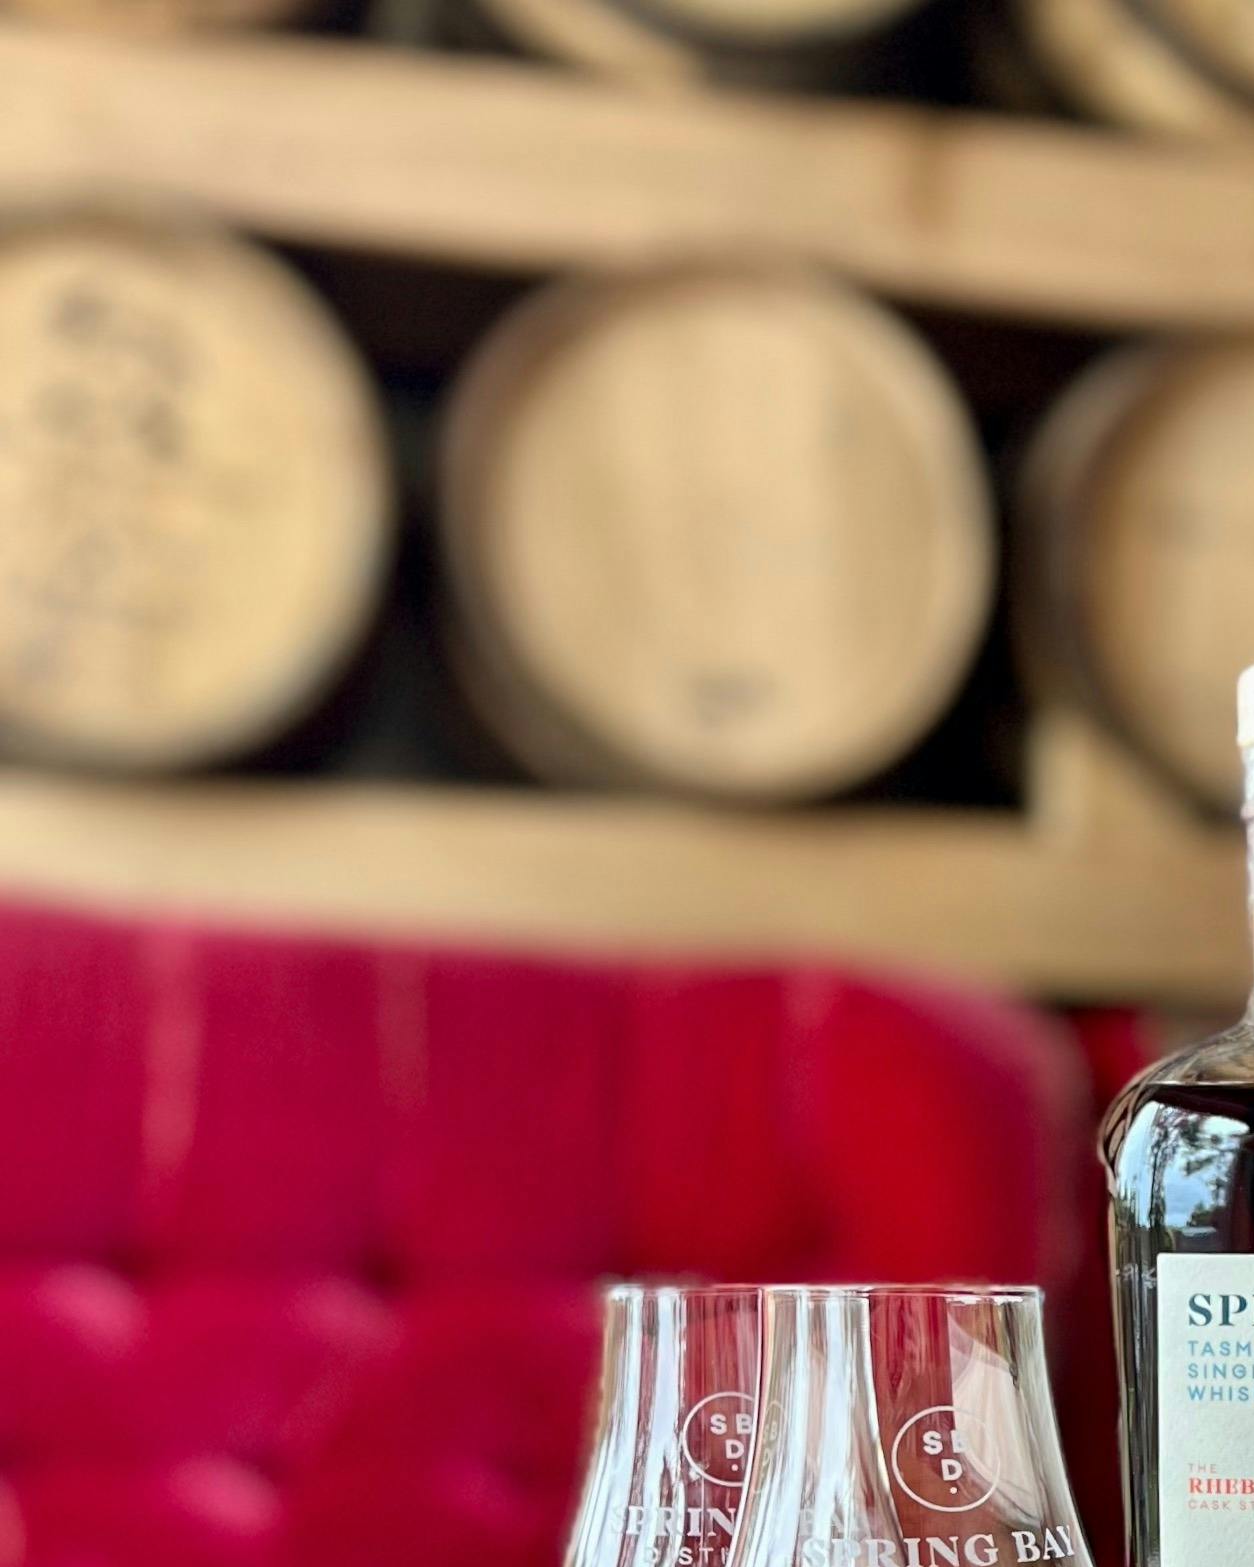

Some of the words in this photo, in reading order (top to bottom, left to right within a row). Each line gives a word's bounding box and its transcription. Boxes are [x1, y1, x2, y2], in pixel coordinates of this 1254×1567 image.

[725, 1438, 745, 1460] D
[941, 1458, 963, 1481] D
[1187, 1462, 1218, 1474] THE
[1187, 1499, 1232, 1511] CASK
[1011, 1525, 1076, 1563] BAY
